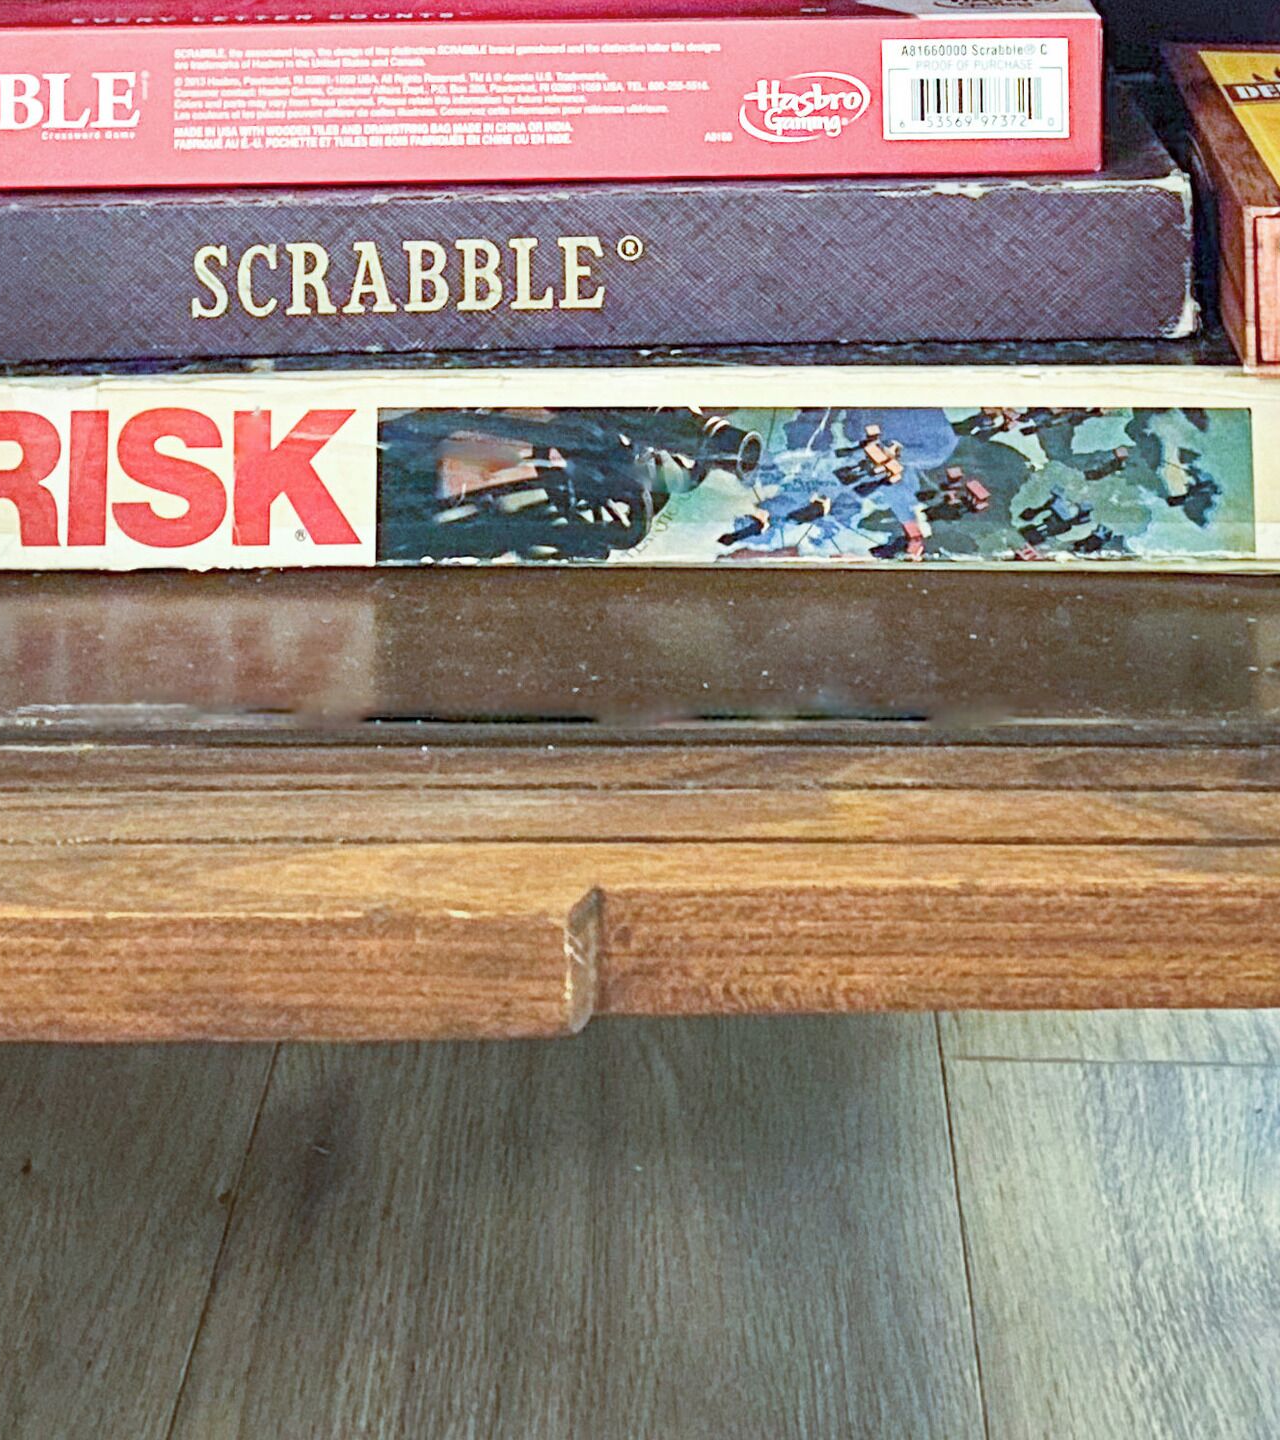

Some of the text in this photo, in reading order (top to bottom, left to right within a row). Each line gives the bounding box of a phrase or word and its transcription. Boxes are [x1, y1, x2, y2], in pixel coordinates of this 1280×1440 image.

[1040, 44, 1048, 55] C
[916, 59, 1033, 71] PROOF OF PURCHASE
[743, 79, 863, 116] Hasbro
[764, 107, 843, 137] Gaming
[980, 115, 1028, 128] 97372
[40, 131, 137, 141] Crossword Game
